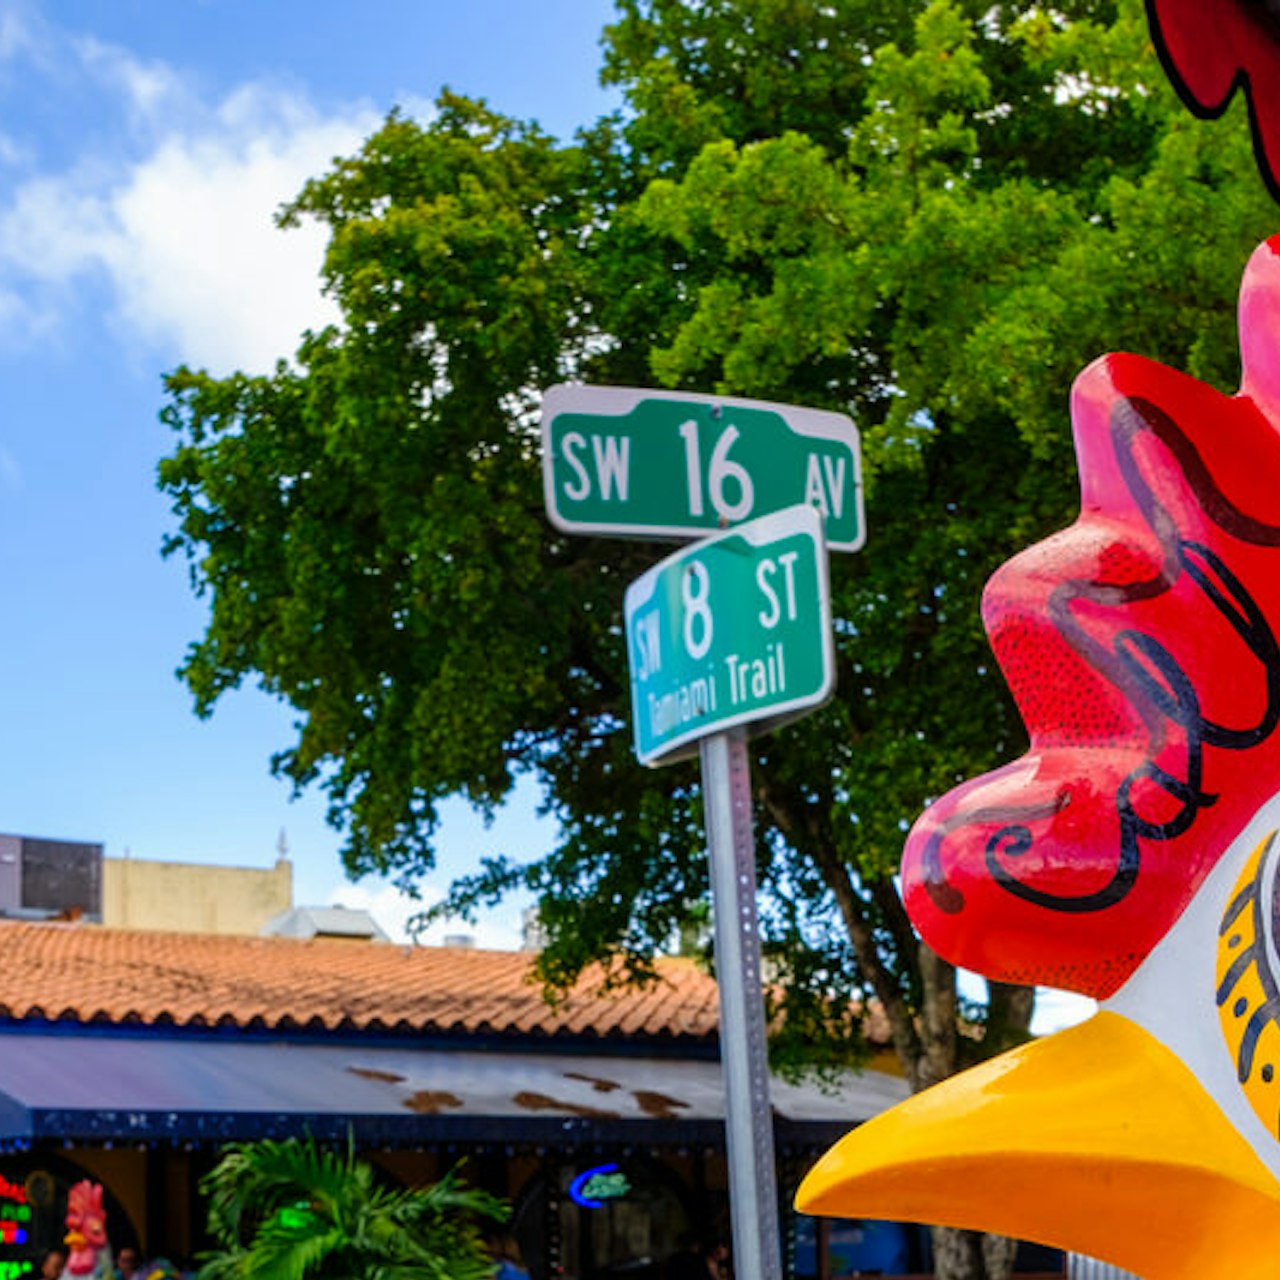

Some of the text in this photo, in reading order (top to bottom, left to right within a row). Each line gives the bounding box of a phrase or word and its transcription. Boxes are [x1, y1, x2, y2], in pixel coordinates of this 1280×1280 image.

[561, 419, 846, 522] SW 16 AV
[635, 551, 799, 682] SW 8 ST
[647, 642, 786, 738] Tamiami Trail
